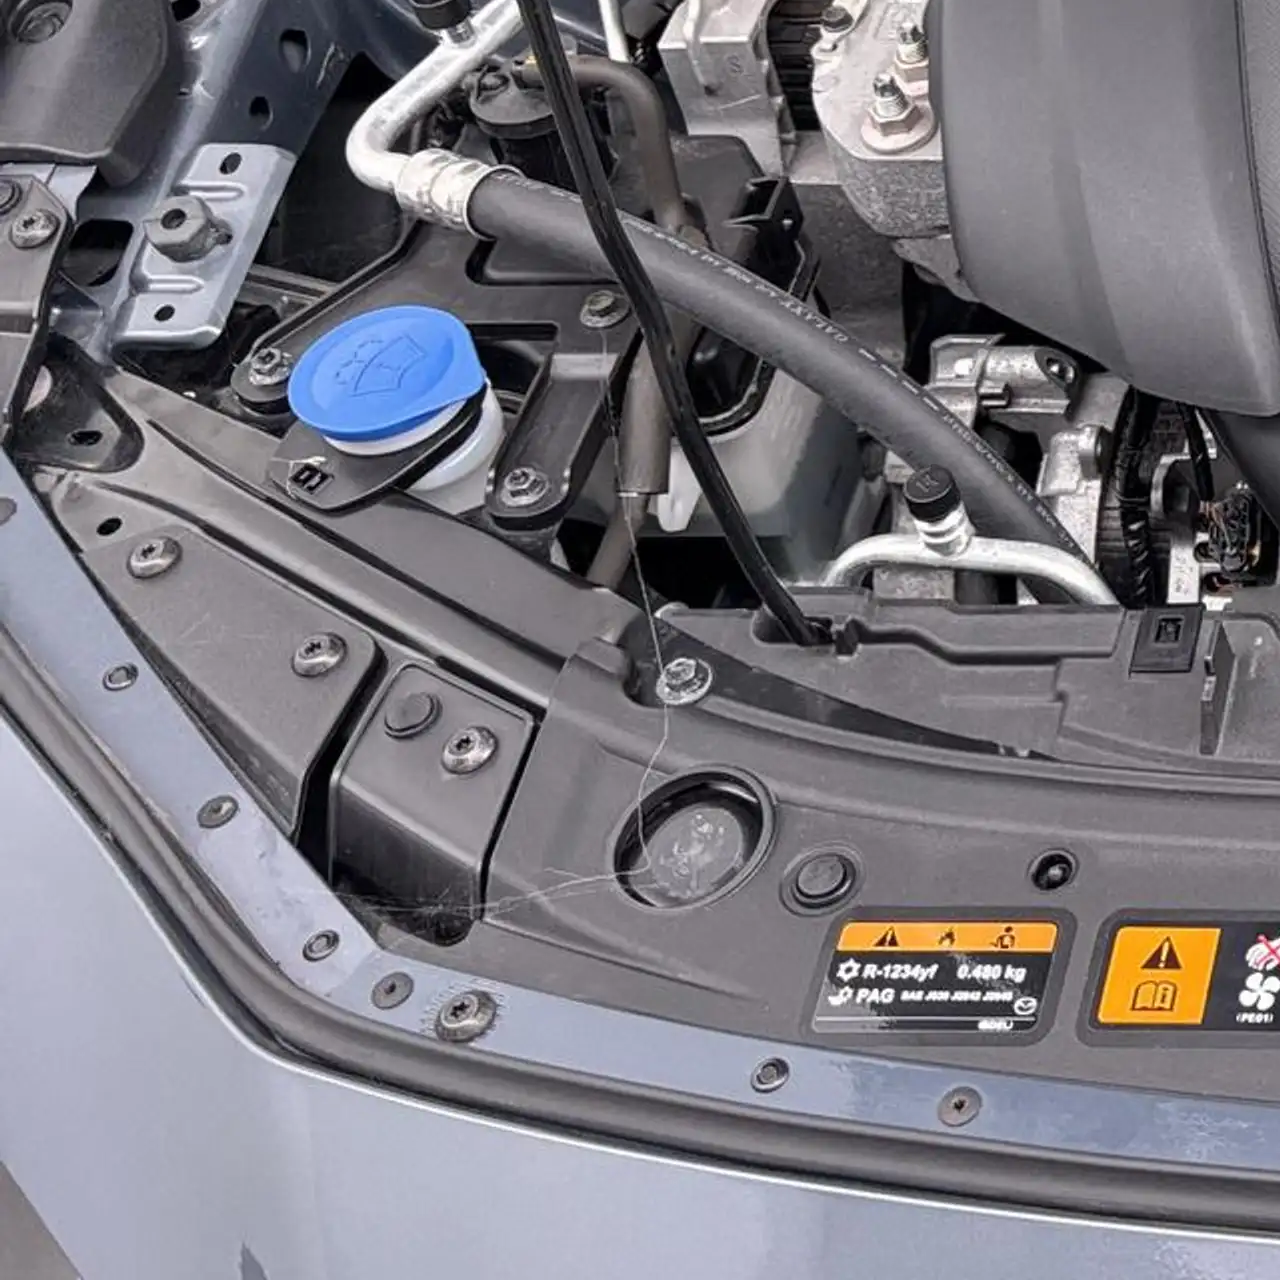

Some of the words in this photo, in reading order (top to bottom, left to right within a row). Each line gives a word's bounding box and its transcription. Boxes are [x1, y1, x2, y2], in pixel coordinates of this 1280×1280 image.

[862, 963, 939, 983] R-1234yf
[1004, 965, 1027, 983] kg
[855, 988, 895, 1004] PAG
